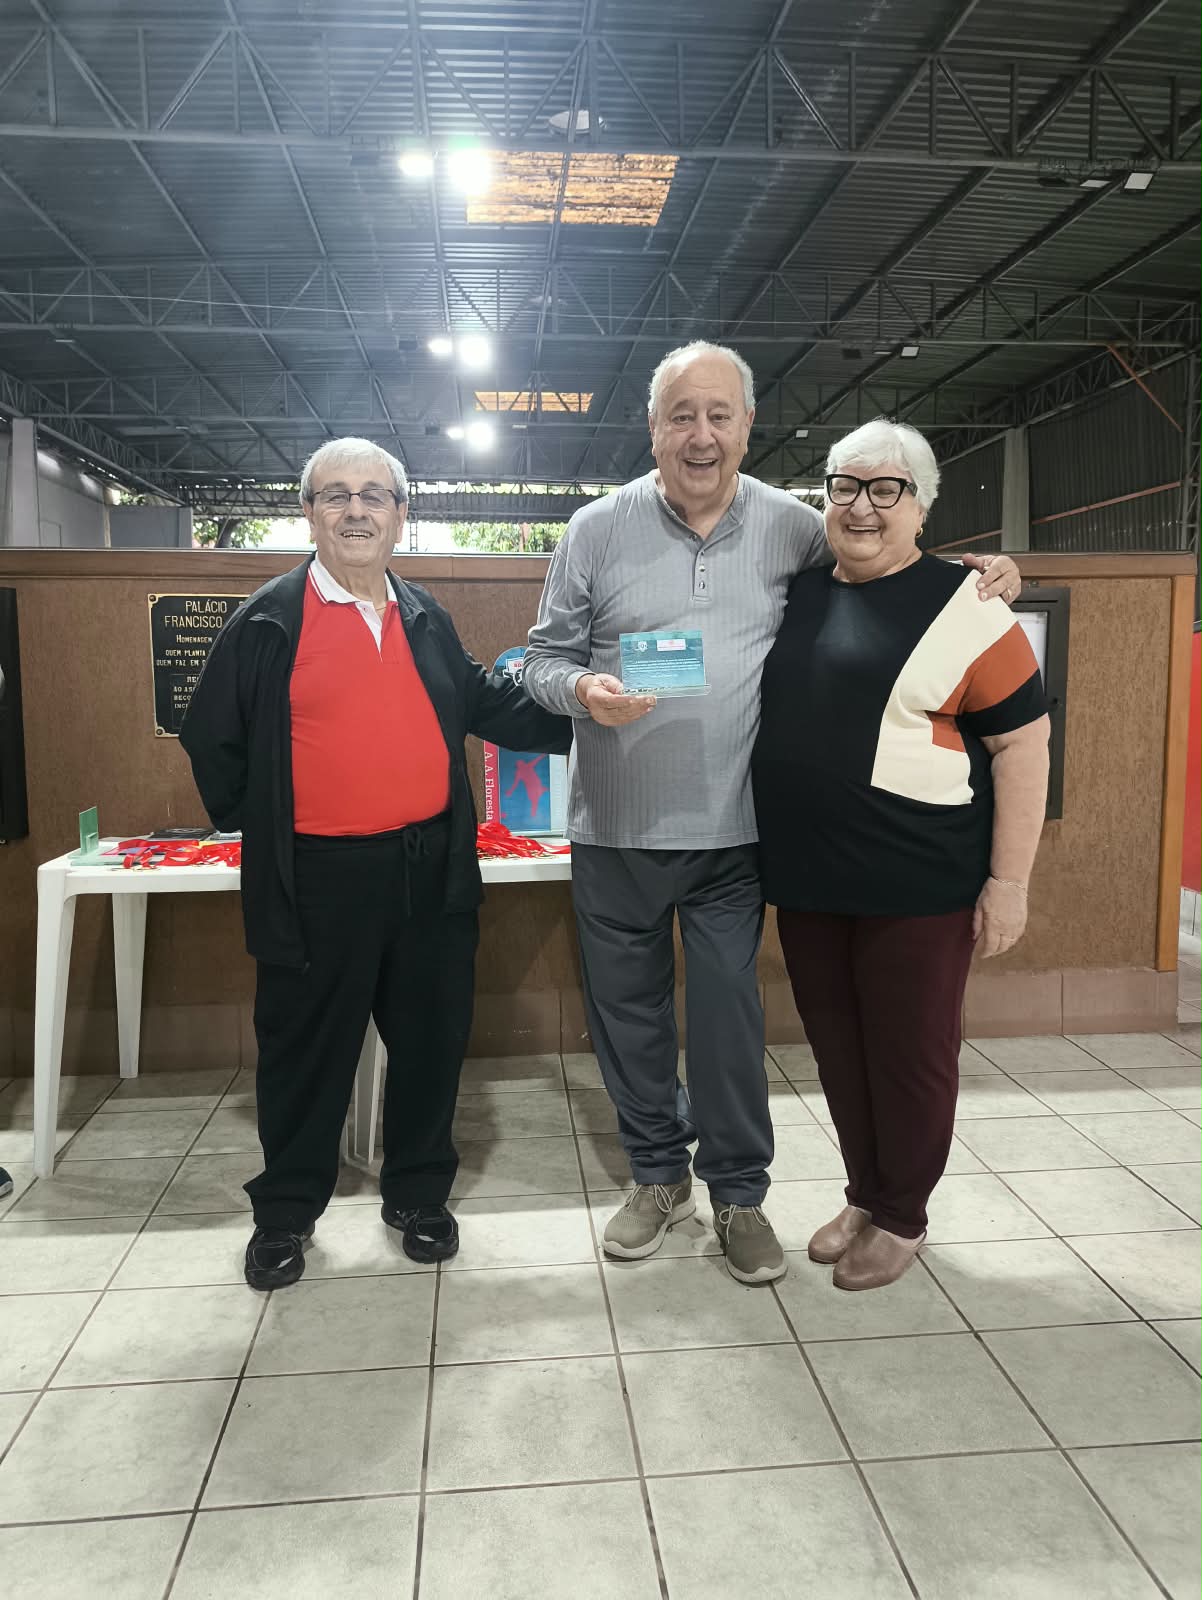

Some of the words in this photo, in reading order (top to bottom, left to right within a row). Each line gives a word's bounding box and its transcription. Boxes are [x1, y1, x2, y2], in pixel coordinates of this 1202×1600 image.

[185, 599, 227, 613] PALÁCIO
[164, 615, 222, 628] FRANCISCO
[156, 659, 171, 667] QUEM
[175, 659, 186, 667] FAZ
[190, 659, 199, 667] EM
[484, 751, 494, 762] A.
[485, 766, 494, 776] A.
[485, 778, 495, 820] Floresta
